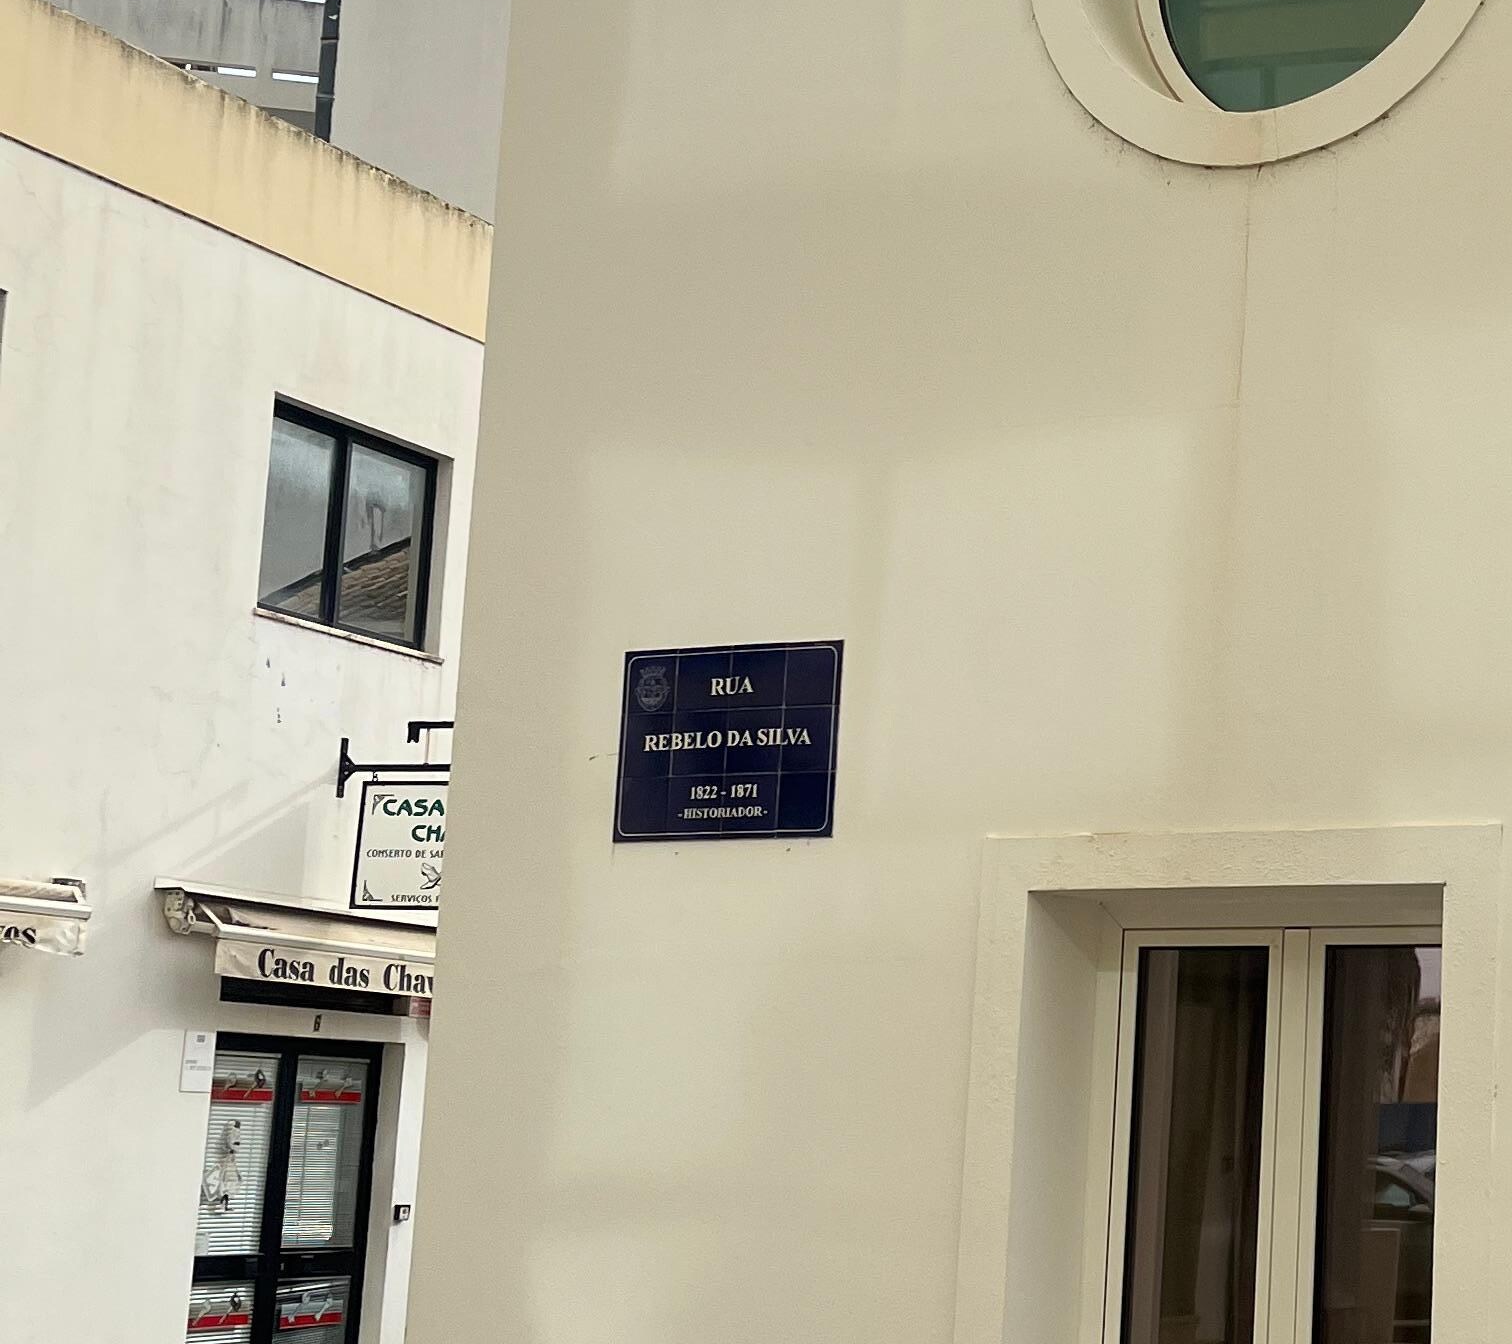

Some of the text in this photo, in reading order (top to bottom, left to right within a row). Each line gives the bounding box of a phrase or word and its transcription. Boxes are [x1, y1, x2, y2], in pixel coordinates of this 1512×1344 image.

[710, 676, 754, 696] RUA
[644, 727, 812, 752] REBELO DA SILVA
[690, 785, 718, 800] 1822
[730, 783, 758, 799] 1871
[383, 799, 445, 816] CASA
[366, 848, 412, 859] CONSERTO
[415, 849, 426, 859] DE
[391, 894, 432, 904] SERVIÇOS
[258, 948, 314, 982] Casa
[329, 957, 370, 989] das
[313, 1014, 322, 1033] 6
